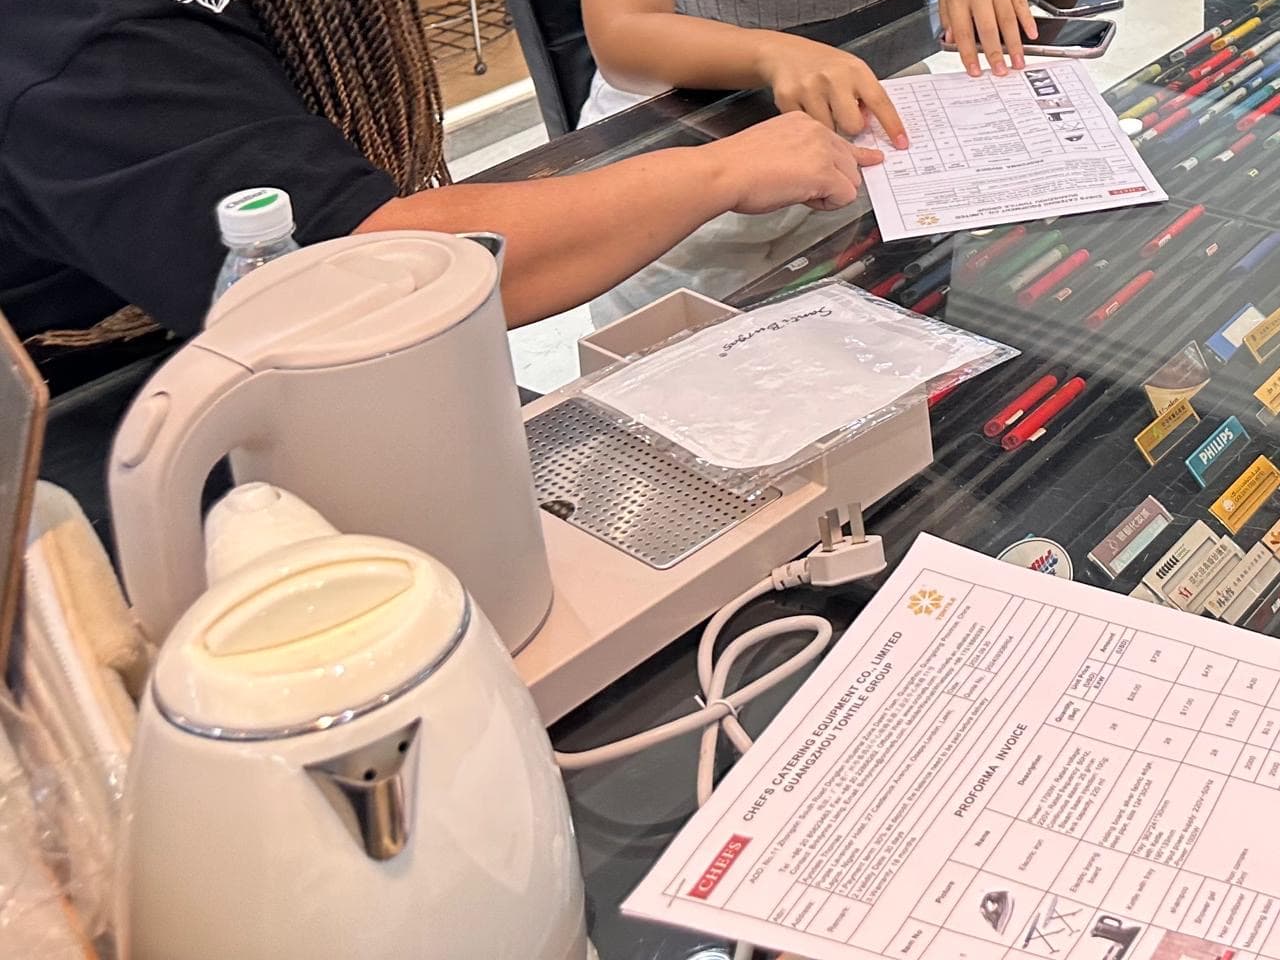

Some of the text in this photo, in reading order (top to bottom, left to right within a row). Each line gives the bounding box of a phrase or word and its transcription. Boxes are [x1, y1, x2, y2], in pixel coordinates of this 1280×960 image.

[1198, 427, 1234, 464] PHILIPS
[1098, 632, 1117, 652] Amount
[1114, 638, 1129, 654] (USD)
[1070, 665, 1091, 689] Unit Price
[1081, 671, 1098, 687] (USD)
[1092, 675, 1106, 688] EXW
[1054, 700, 1075, 722] Quantity
[741, 630, 904, 821] CHEFS CATERING EQUIPMENT CO., LIMITED
[781, 732, 838, 793] GUANGZHOU
[832, 694, 869, 731] TONTILE
[864, 661, 896, 693] GROUP
[906, 791, 917, 800] the
[913, 770, 933, 791] balance
[929, 756, 943, 770] need
[949, 732, 962, 743] paid
[958, 715, 974, 732] before
[1017, 753, 1044, 785] Description
[953, 722, 1029, 817] PROFORMA INVOICE
[820, 834, 842, 857] Thomas
[890, 830, 905, 845] days
[896, 836, 917, 858] months
[974, 829, 991, 846] Name
[696, 840, 744, 893] CHEFS
[1017, 849, 1037, 870] Electric
[934, 880, 956, 903] Picture
[1069, 871, 1088, 892] Electric
[1125, 892, 1141, 909] Kettle
[1168, 885, 1190, 914] shampoo
[1193, 890, 1219, 924] Shower gel
[1216, 892, 1247, 938] Hair conditioner
[901, 939, 916, 953] Item
